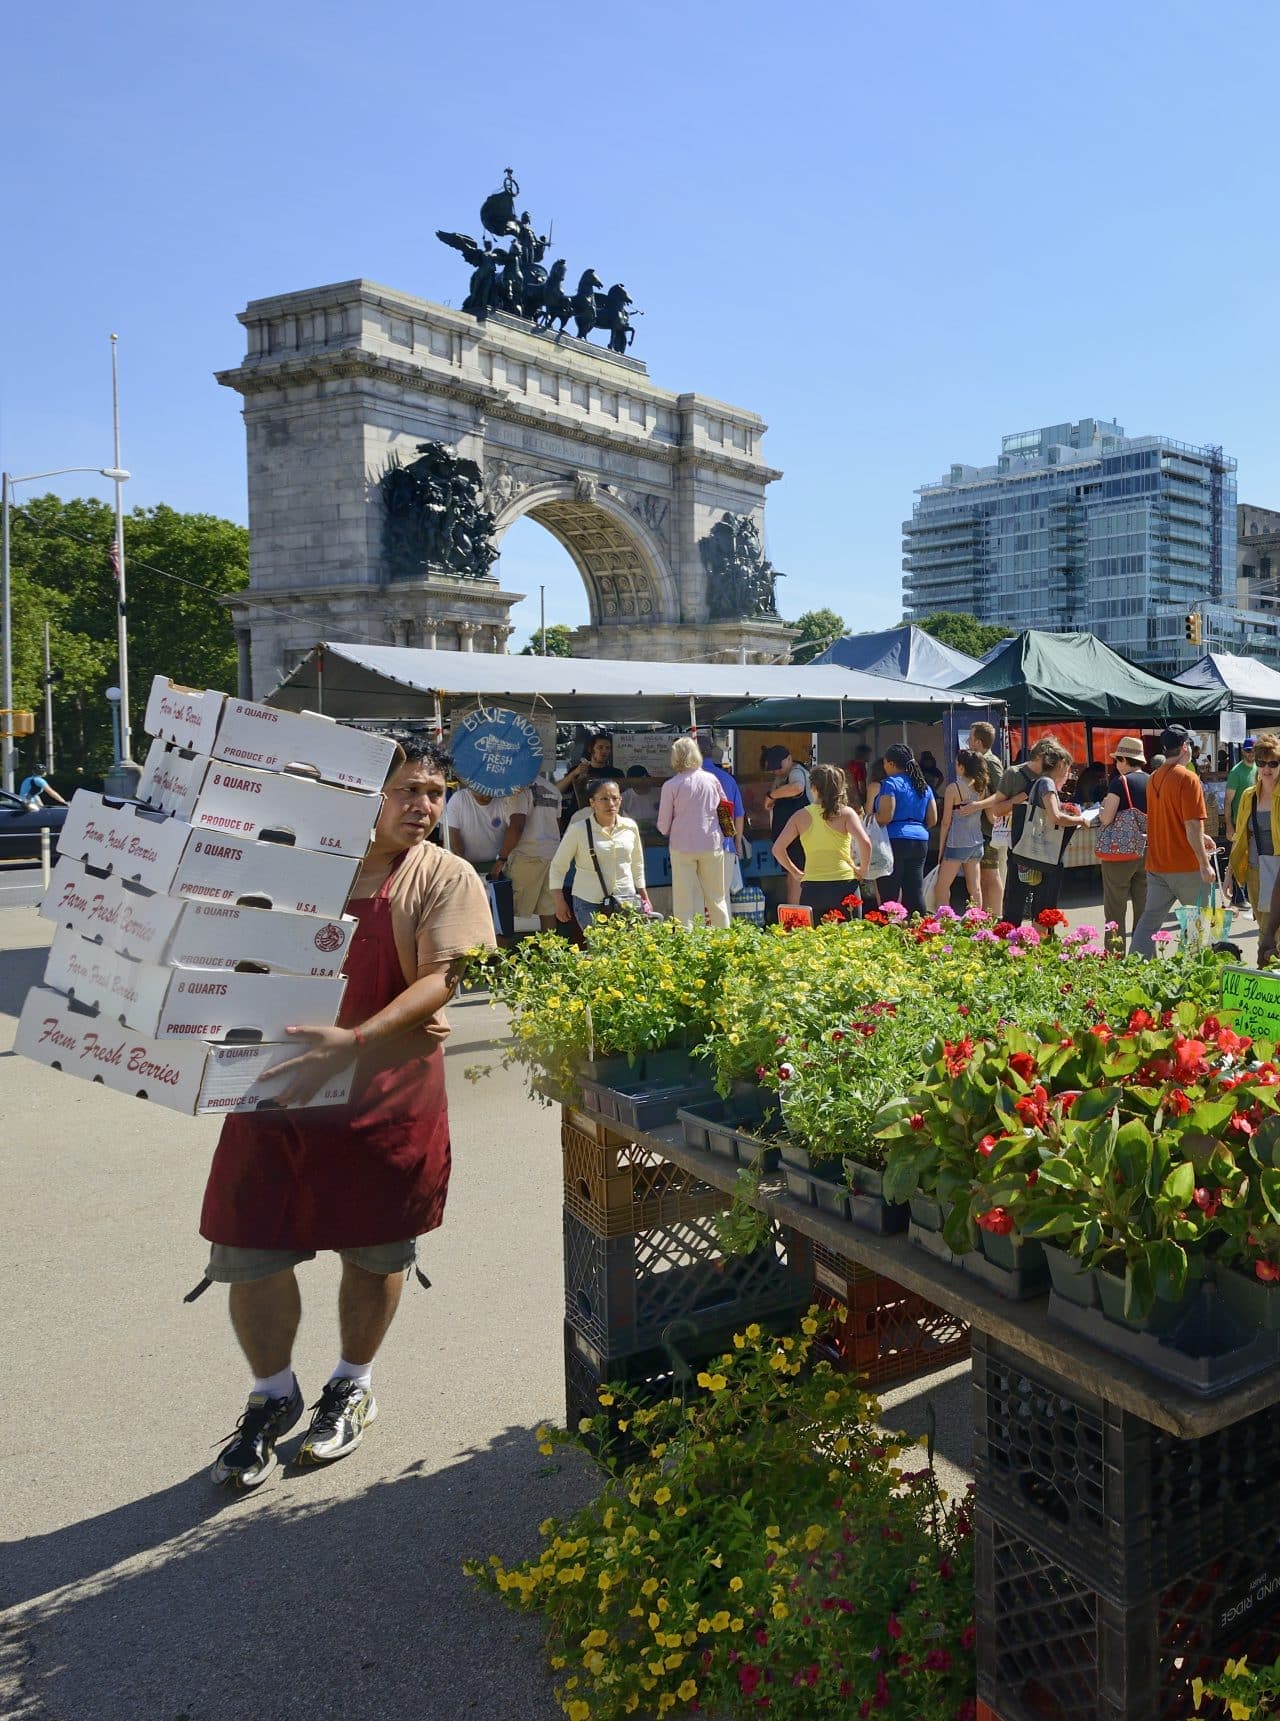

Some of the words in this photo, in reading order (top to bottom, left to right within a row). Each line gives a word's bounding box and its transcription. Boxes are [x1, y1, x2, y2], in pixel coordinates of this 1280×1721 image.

[244, 708, 279, 722] QUARTS
[463, 707, 506, 732] BLUE
[512, 715, 544, 757] MOON
[223, 746, 264, 762] PRODUCE
[266, 756, 278, 765] OF
[482, 753, 512, 766] FRESH
[486, 763, 506, 774] FISH
[214, 774, 221, 785] 8
[223, 776, 262, 794] QUARTS
[201, 814, 241, 831] PRODUCE
[242, 822, 256, 832] OF
[82, 822, 104, 844] Farm
[195, 842, 202, 852] 8
[204, 844, 243, 861] QUARTS
[180, 884, 220, 898] PRODUCE
[222, 890, 234, 899] OF
[58, 882, 88, 912] Farm
[88, 894, 122, 924] Fresh
[195, 906, 201, 914] 8
[202, 907, 240, 919] QUARTS
[181, 955, 224, 967] PRODUCE
[225, 958, 237, 967] OF
[178, 983, 184, 992] 8
[188, 984, 228, 996] QUARTS
[1222, 972, 1240, 996] All
[166, 1024, 208, 1034] PRODUCE
[210, 1025, 222, 1034] OF
[38, 1018, 77, 1050] Farm
[80, 1033, 126, 1066] Fresh
[127, 1048, 181, 1086] Berries
[225, 1049, 259, 1058] QUARTS
[207, 1097, 243, 1108] PRODUCE
[248, 1096, 260, 1104] OF
[1221, 1594, 1253, 1628] RIDGE
